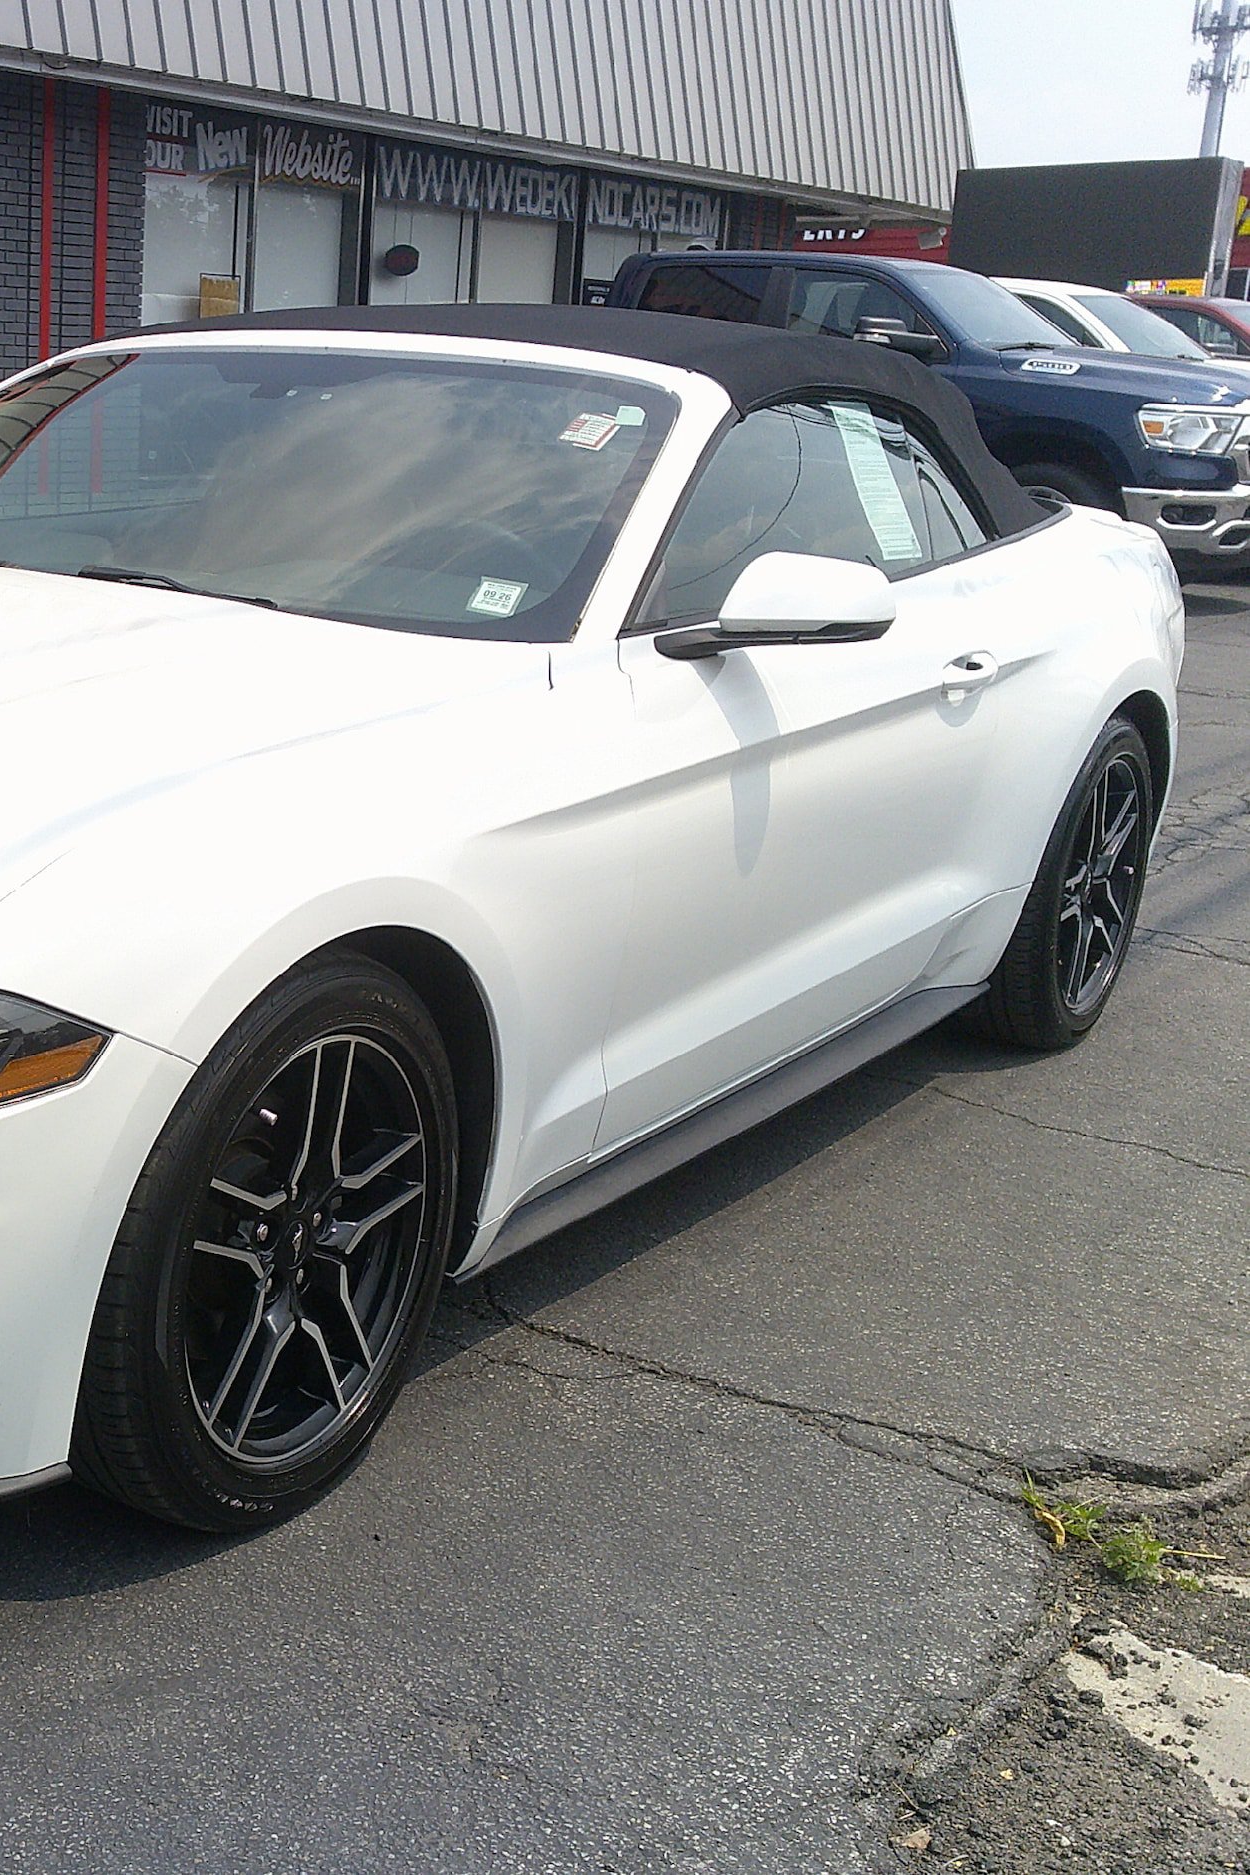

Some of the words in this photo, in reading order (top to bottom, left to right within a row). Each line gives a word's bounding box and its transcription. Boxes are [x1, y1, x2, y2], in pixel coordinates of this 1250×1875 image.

[146, 105, 193, 138] VISIT
[146, 139, 185, 170] OUR
[196, 121, 248, 171] New
[483, 590, 496, 598] 09
[498, 593, 512, 601] 26
